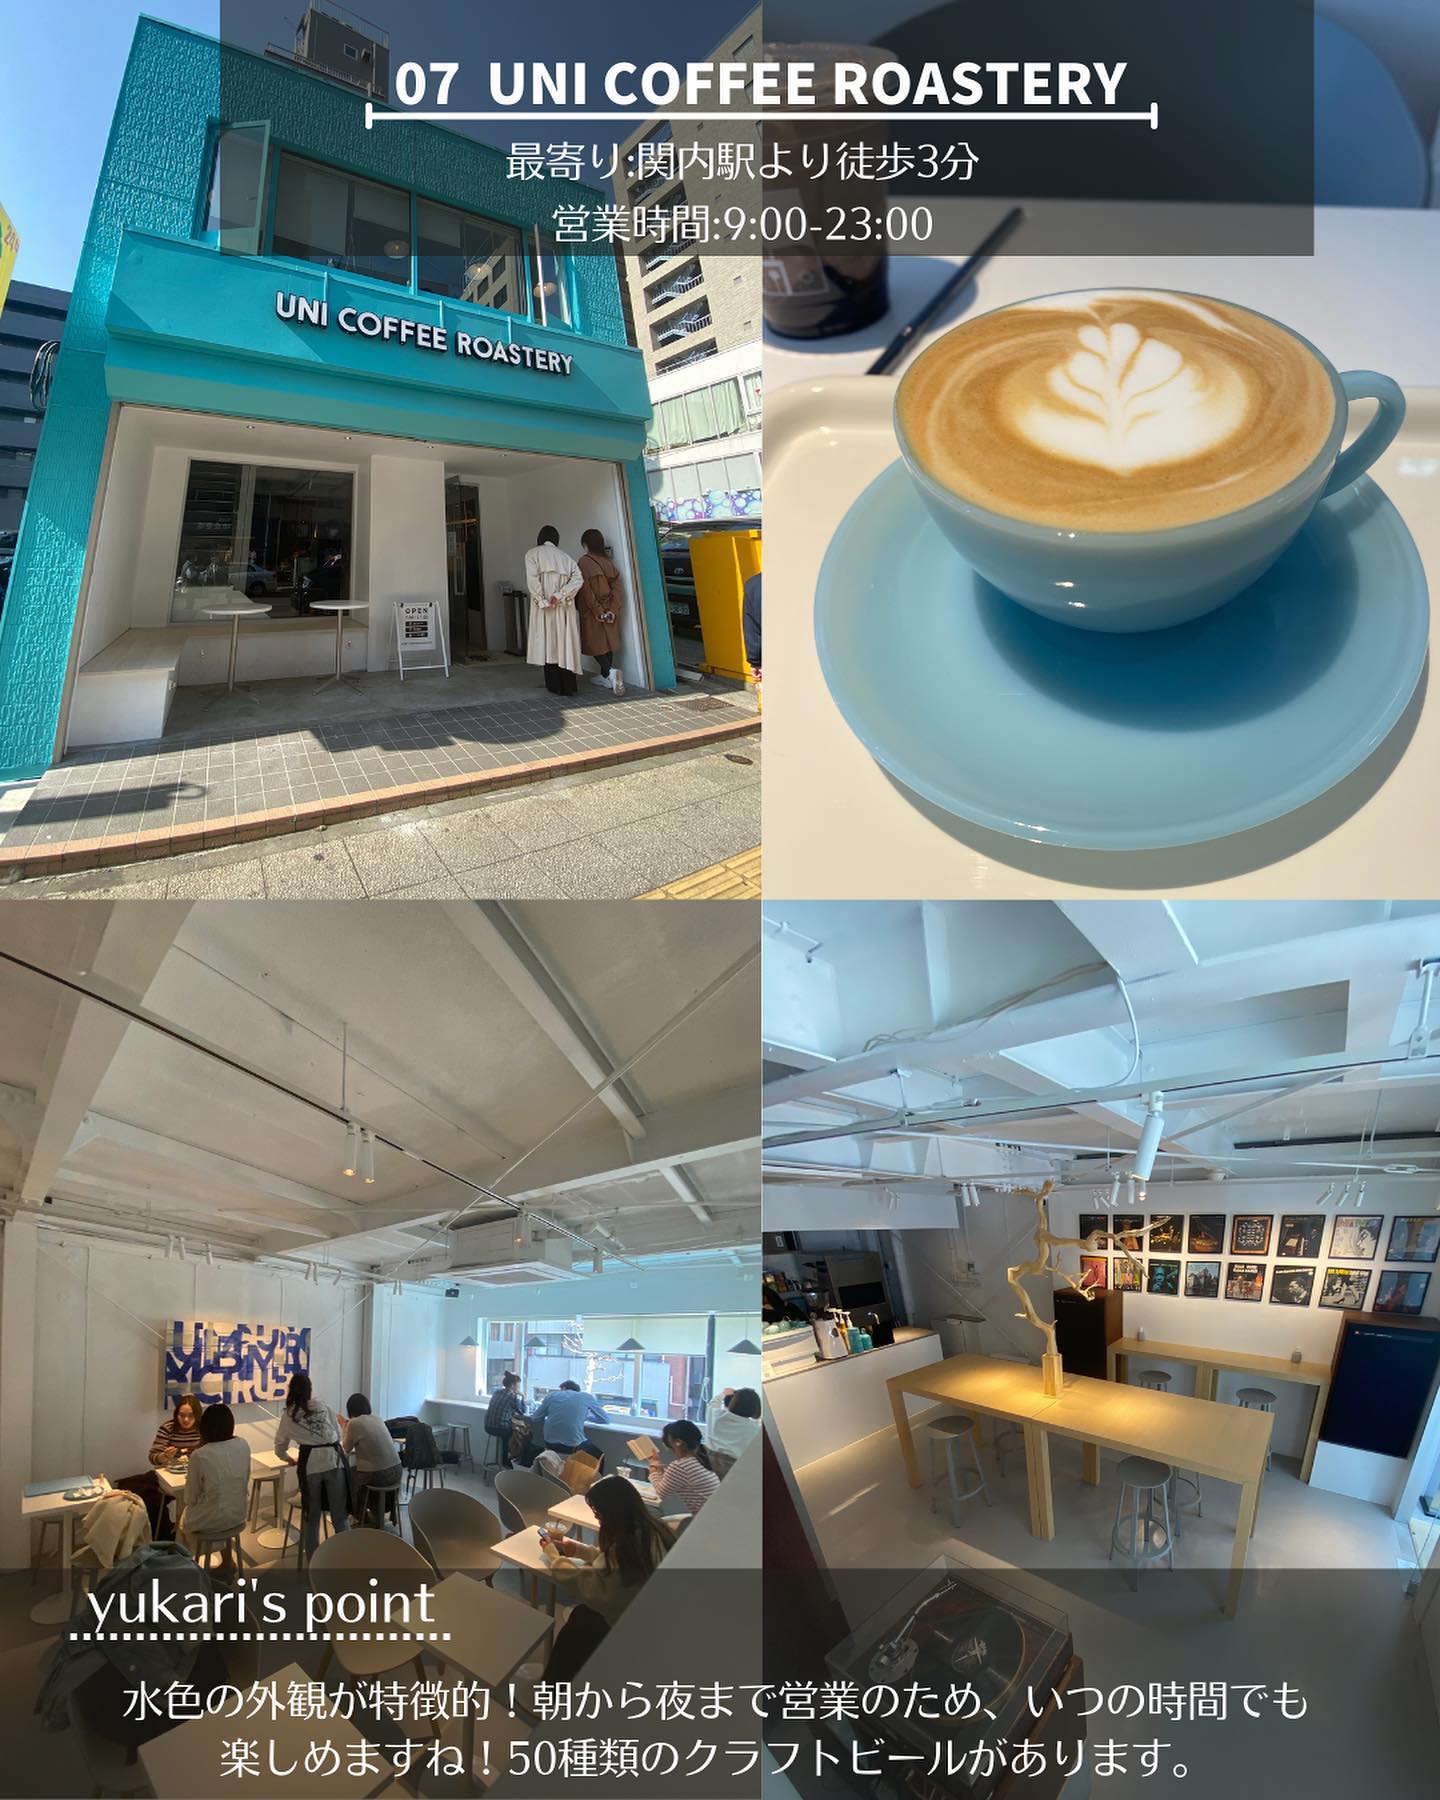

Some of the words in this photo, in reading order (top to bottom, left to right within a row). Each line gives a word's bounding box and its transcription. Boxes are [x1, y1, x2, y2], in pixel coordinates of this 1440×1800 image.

[276, 291, 328, 327] UNI
[337, 307, 448, 351] COFFEE
[456, 330, 573, 376] ROASTERY
